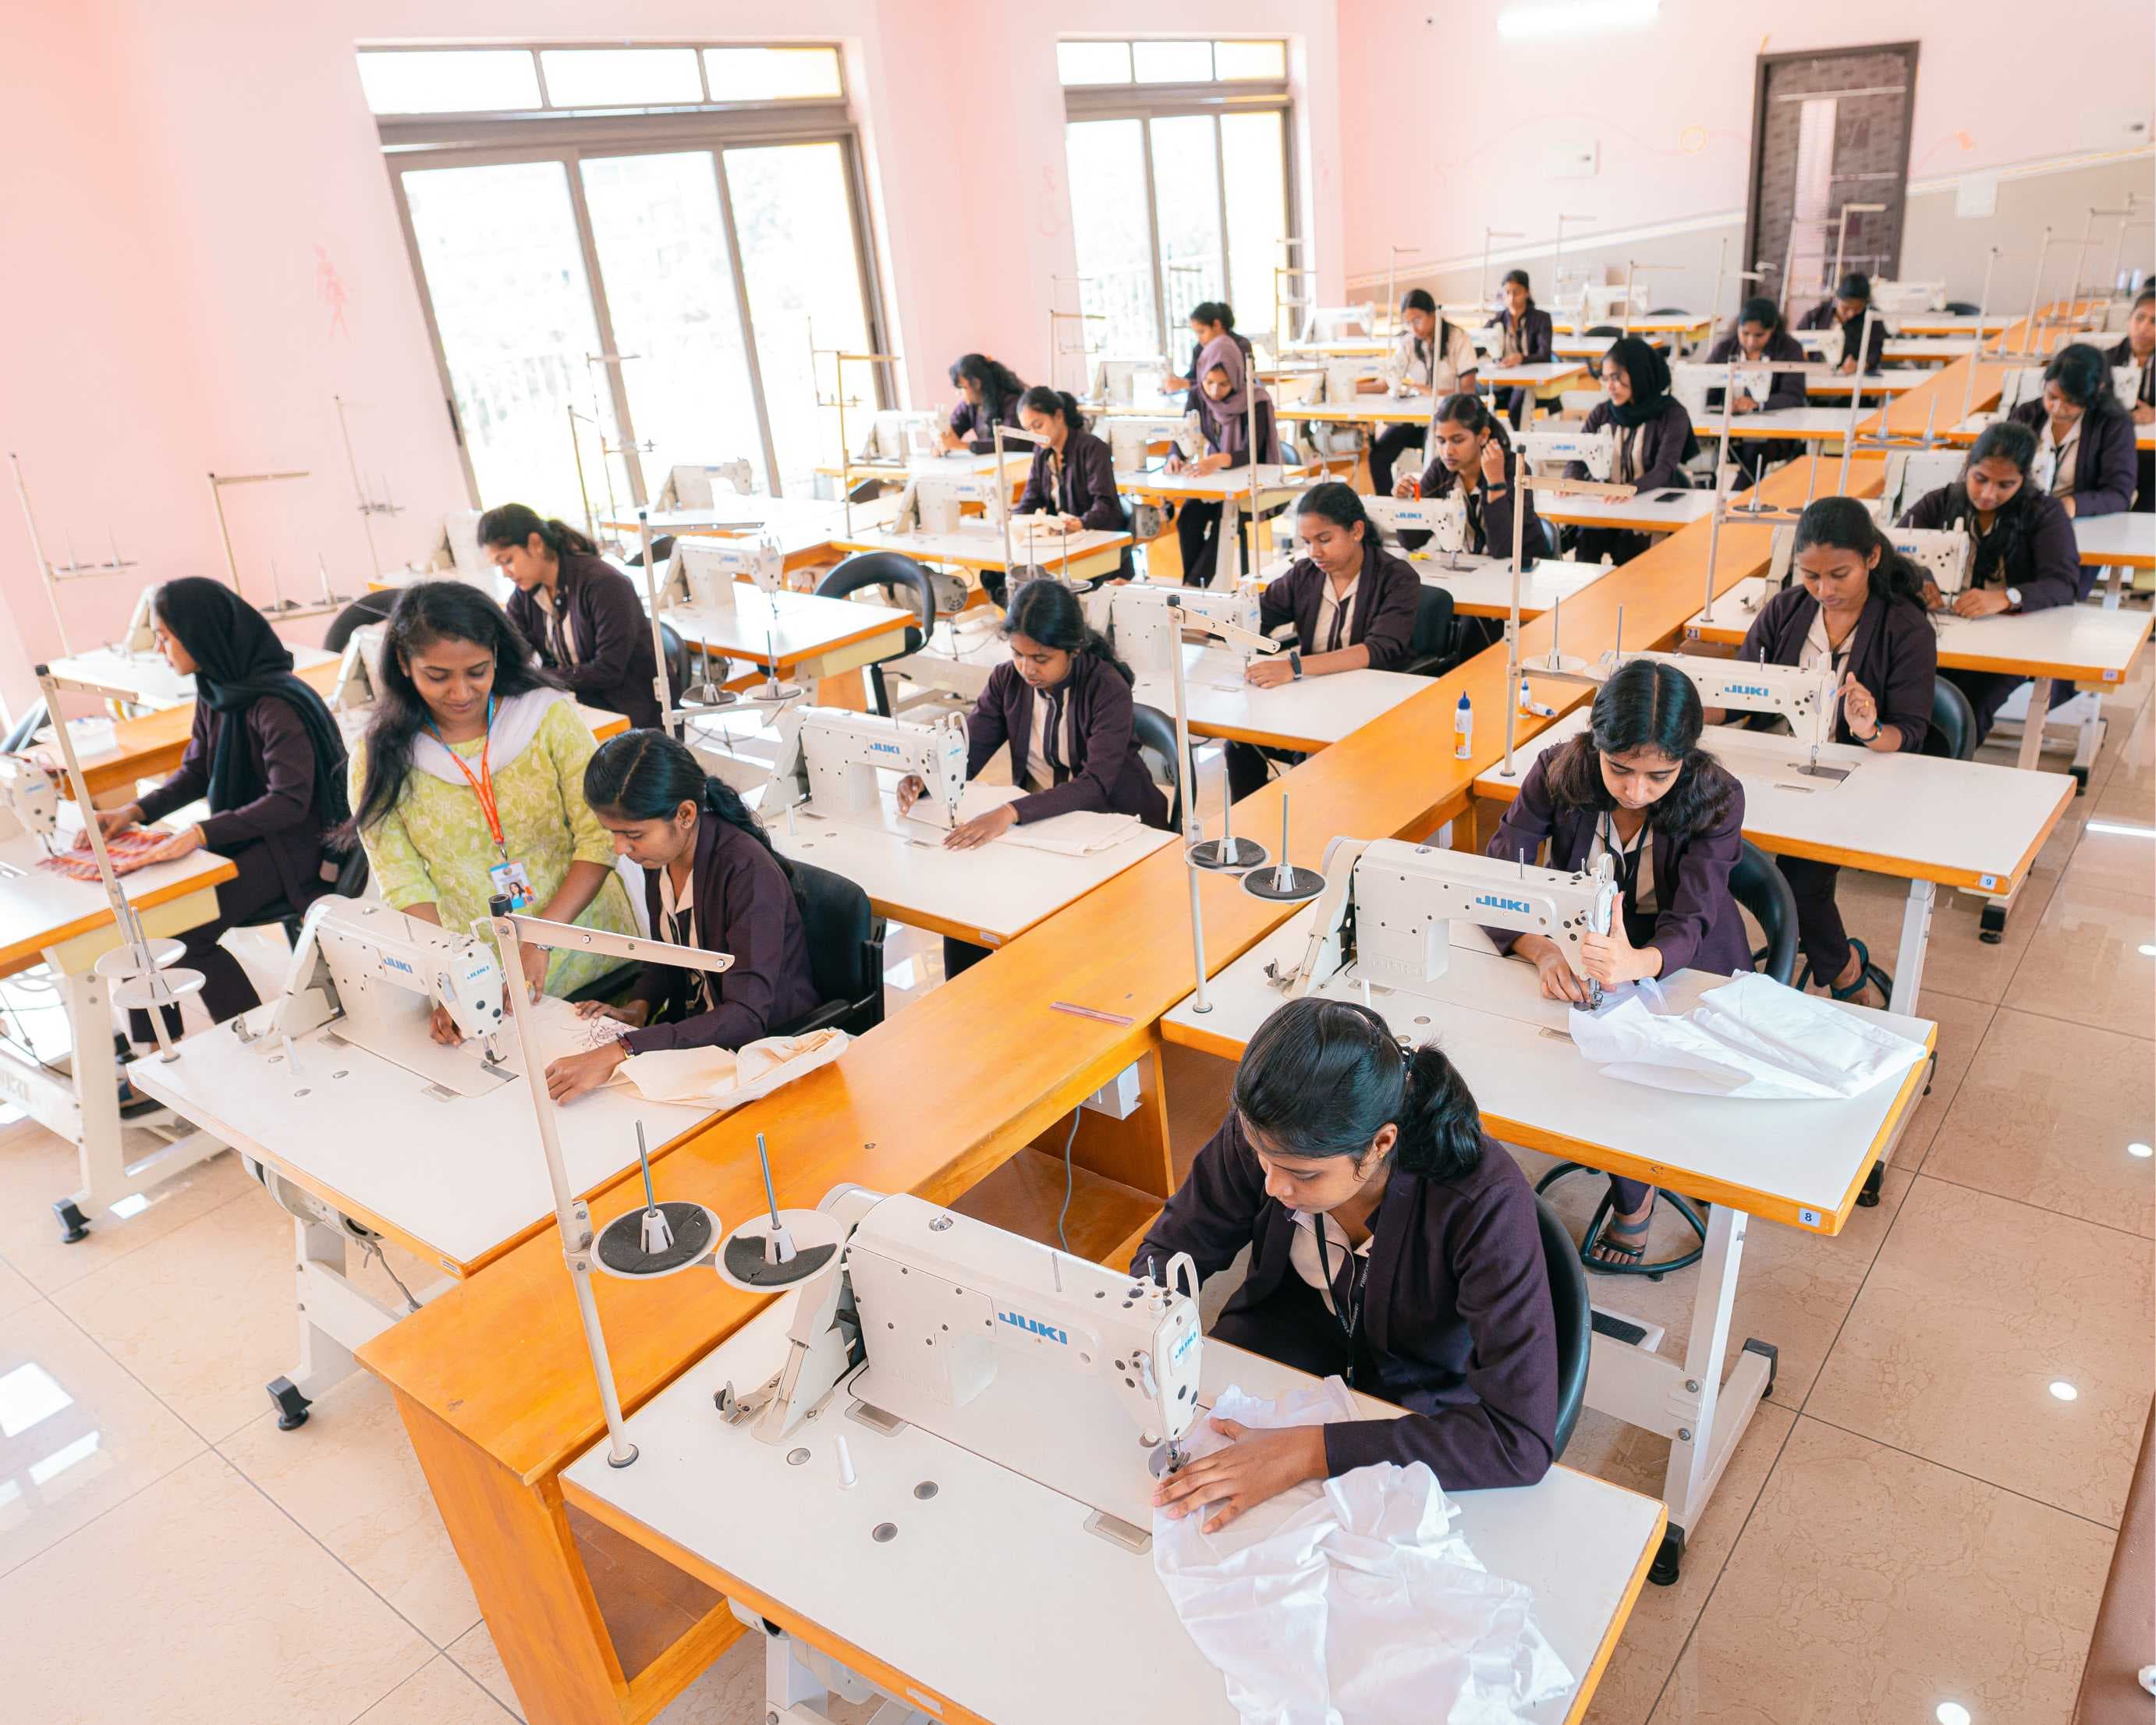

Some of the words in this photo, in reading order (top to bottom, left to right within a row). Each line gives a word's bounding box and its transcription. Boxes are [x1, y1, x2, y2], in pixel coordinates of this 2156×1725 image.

[1686, 628, 1698, 638] 21
[1724, 685, 1769, 697] JUKI
[869, 743, 900, 754] JUKI
[1475, 895, 1530, 914] JUKI
[382, 956, 413, 974] JUKI
[1804, 1212, 1812, 1223] 8
[998, 1312, 1068, 1346] JUKI
[1174, 1331, 1197, 1360] JUKI
